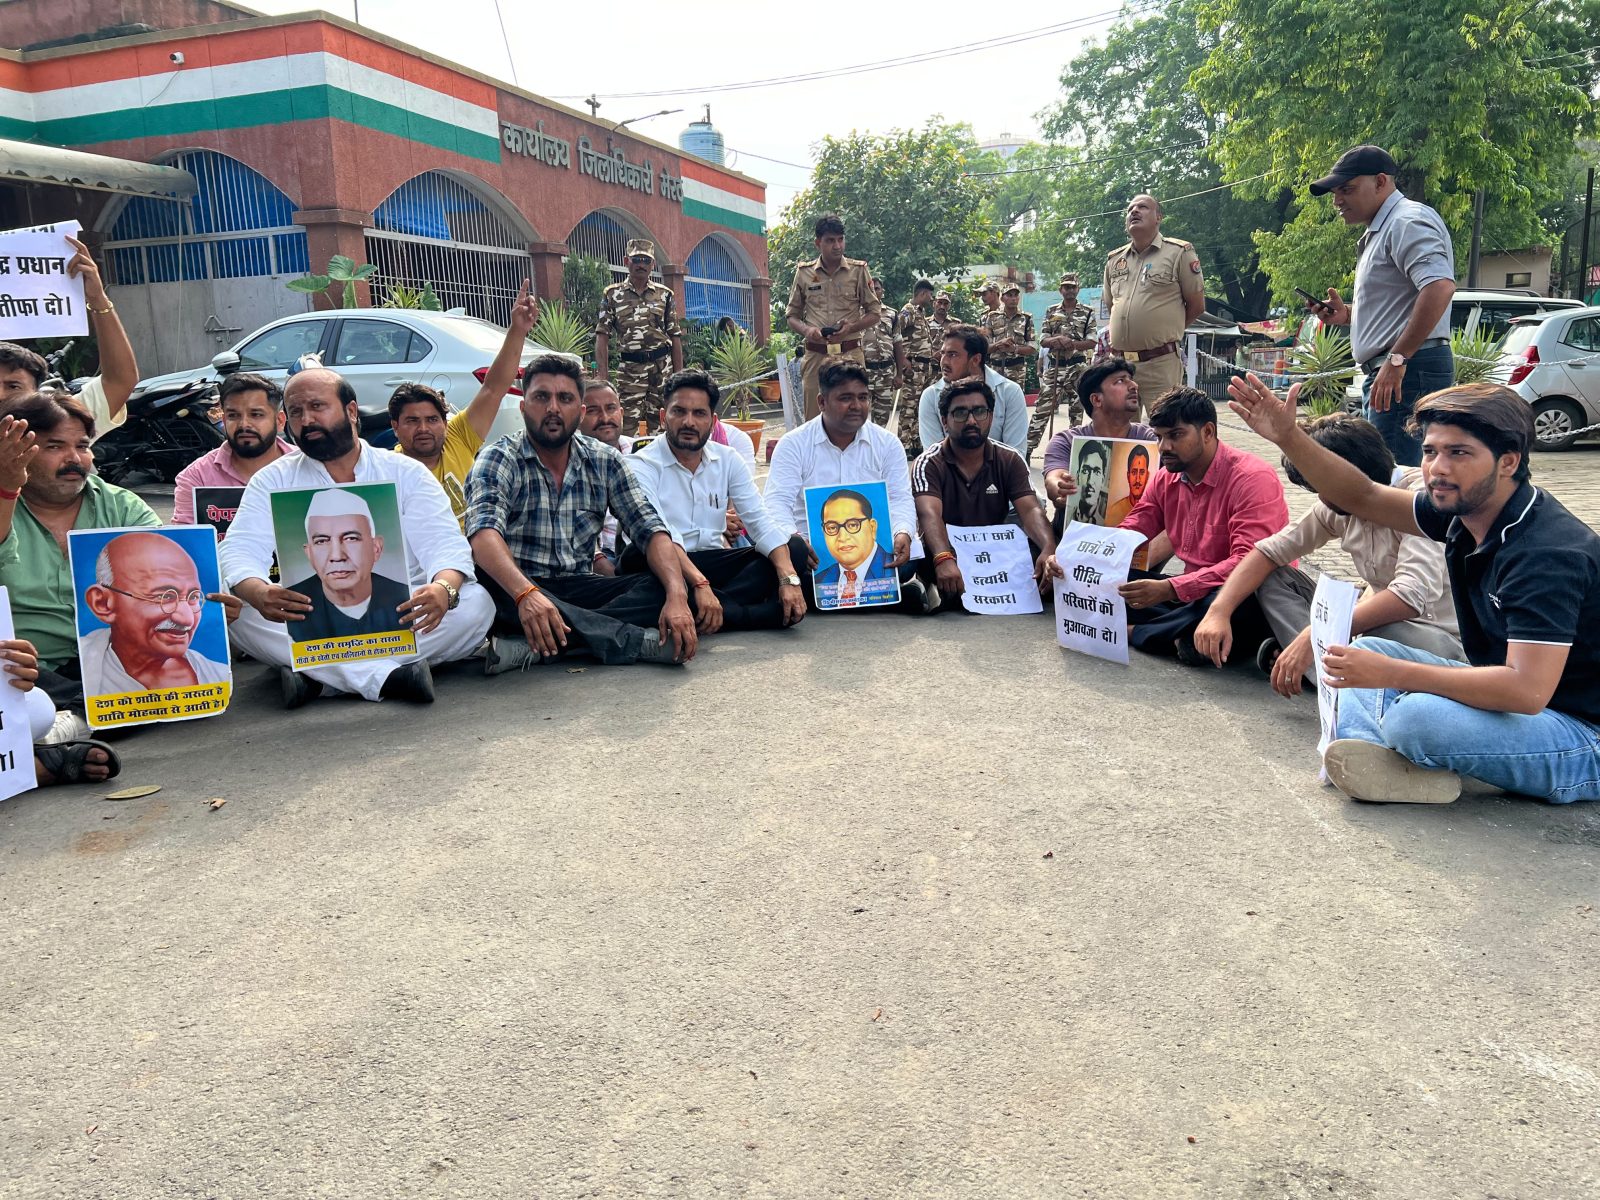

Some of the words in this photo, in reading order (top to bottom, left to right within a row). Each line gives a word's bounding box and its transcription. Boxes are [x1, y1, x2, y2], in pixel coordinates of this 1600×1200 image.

[500, 119, 571, 169] कार्यालय
[577, 135, 655, 195] जिलाधिकारी
[16, 256, 65, 275] प्रधान
[43, 293, 72, 316] दो।
[954, 532, 988, 543] NEET
[992, 529, 1015, 540] छात्रों
[974, 551, 991, 564] की
[1077, 540, 1105, 555] छात्रों
[1102, 542, 1116, 557] के
[972, 571, 1009, 586] हत्यारी
[1073, 565, 1103, 588] पीड़ित
[973, 593, 1017, 604] सरकार।
[1062, 592, 1097, 612] परिवारों
[1099, 598, 1114, 616] को
[1063, 618, 1097, 639] मुआवजा
[1101, 627, 1117, 644] दो।
[323, 641, 334, 650] की
[95, 699, 115, 709] देश
[117, 697, 133, 706] को
[163, 691, 179, 701] की
[214, 686, 223, 695] है
[170, 705, 181, 714] से
[184, 700, 212, 712] आती
